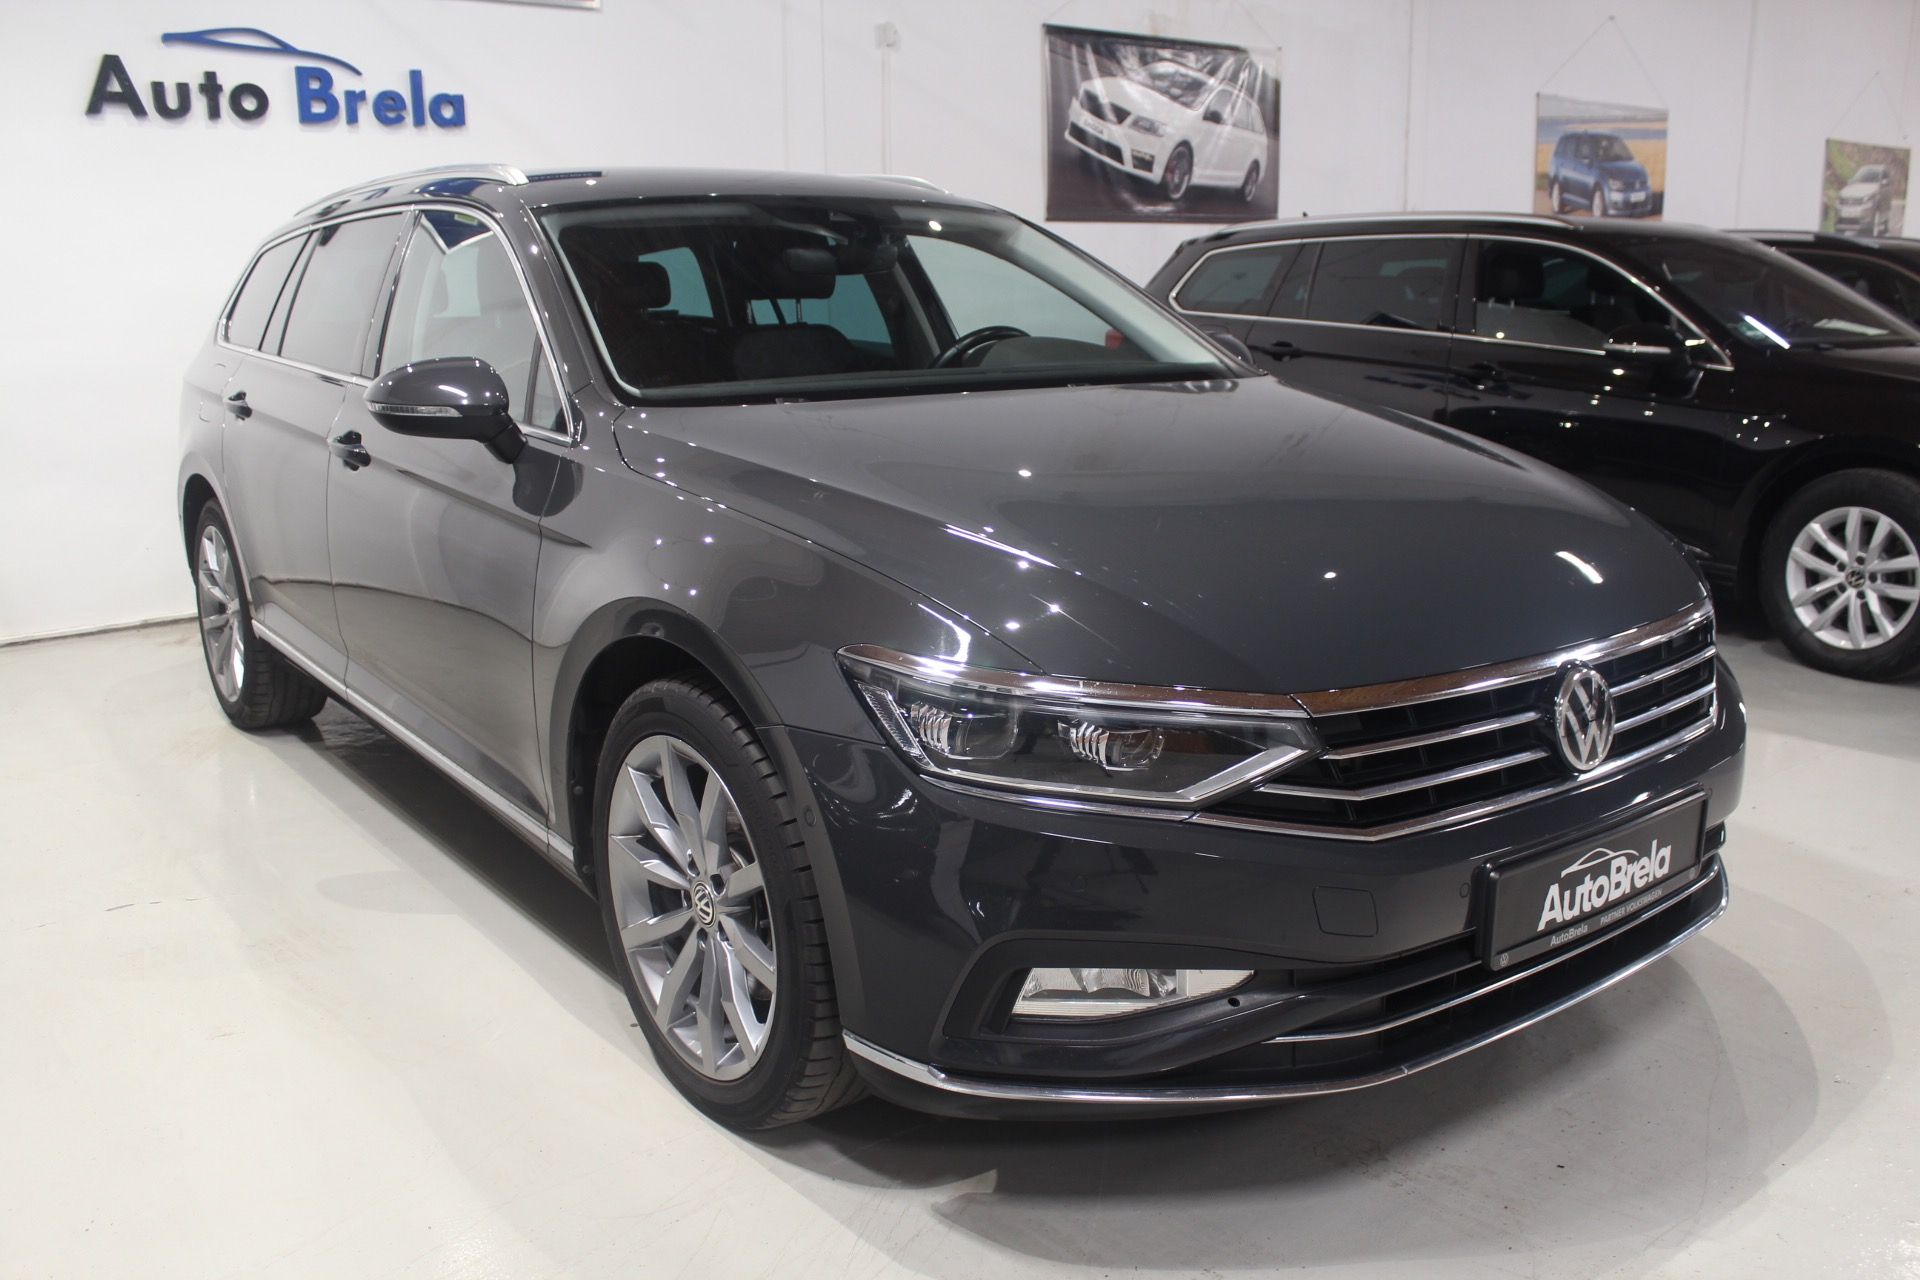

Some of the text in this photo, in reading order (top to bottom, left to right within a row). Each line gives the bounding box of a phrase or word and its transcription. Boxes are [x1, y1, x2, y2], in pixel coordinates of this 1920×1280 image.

[86, 54, 466, 128] Auto Brela
[1537, 840, 1671, 932] AutoBrela
[1550, 924, 1588, 946] AutoBrela
[1600, 907, 1625, 925] PARTNER
